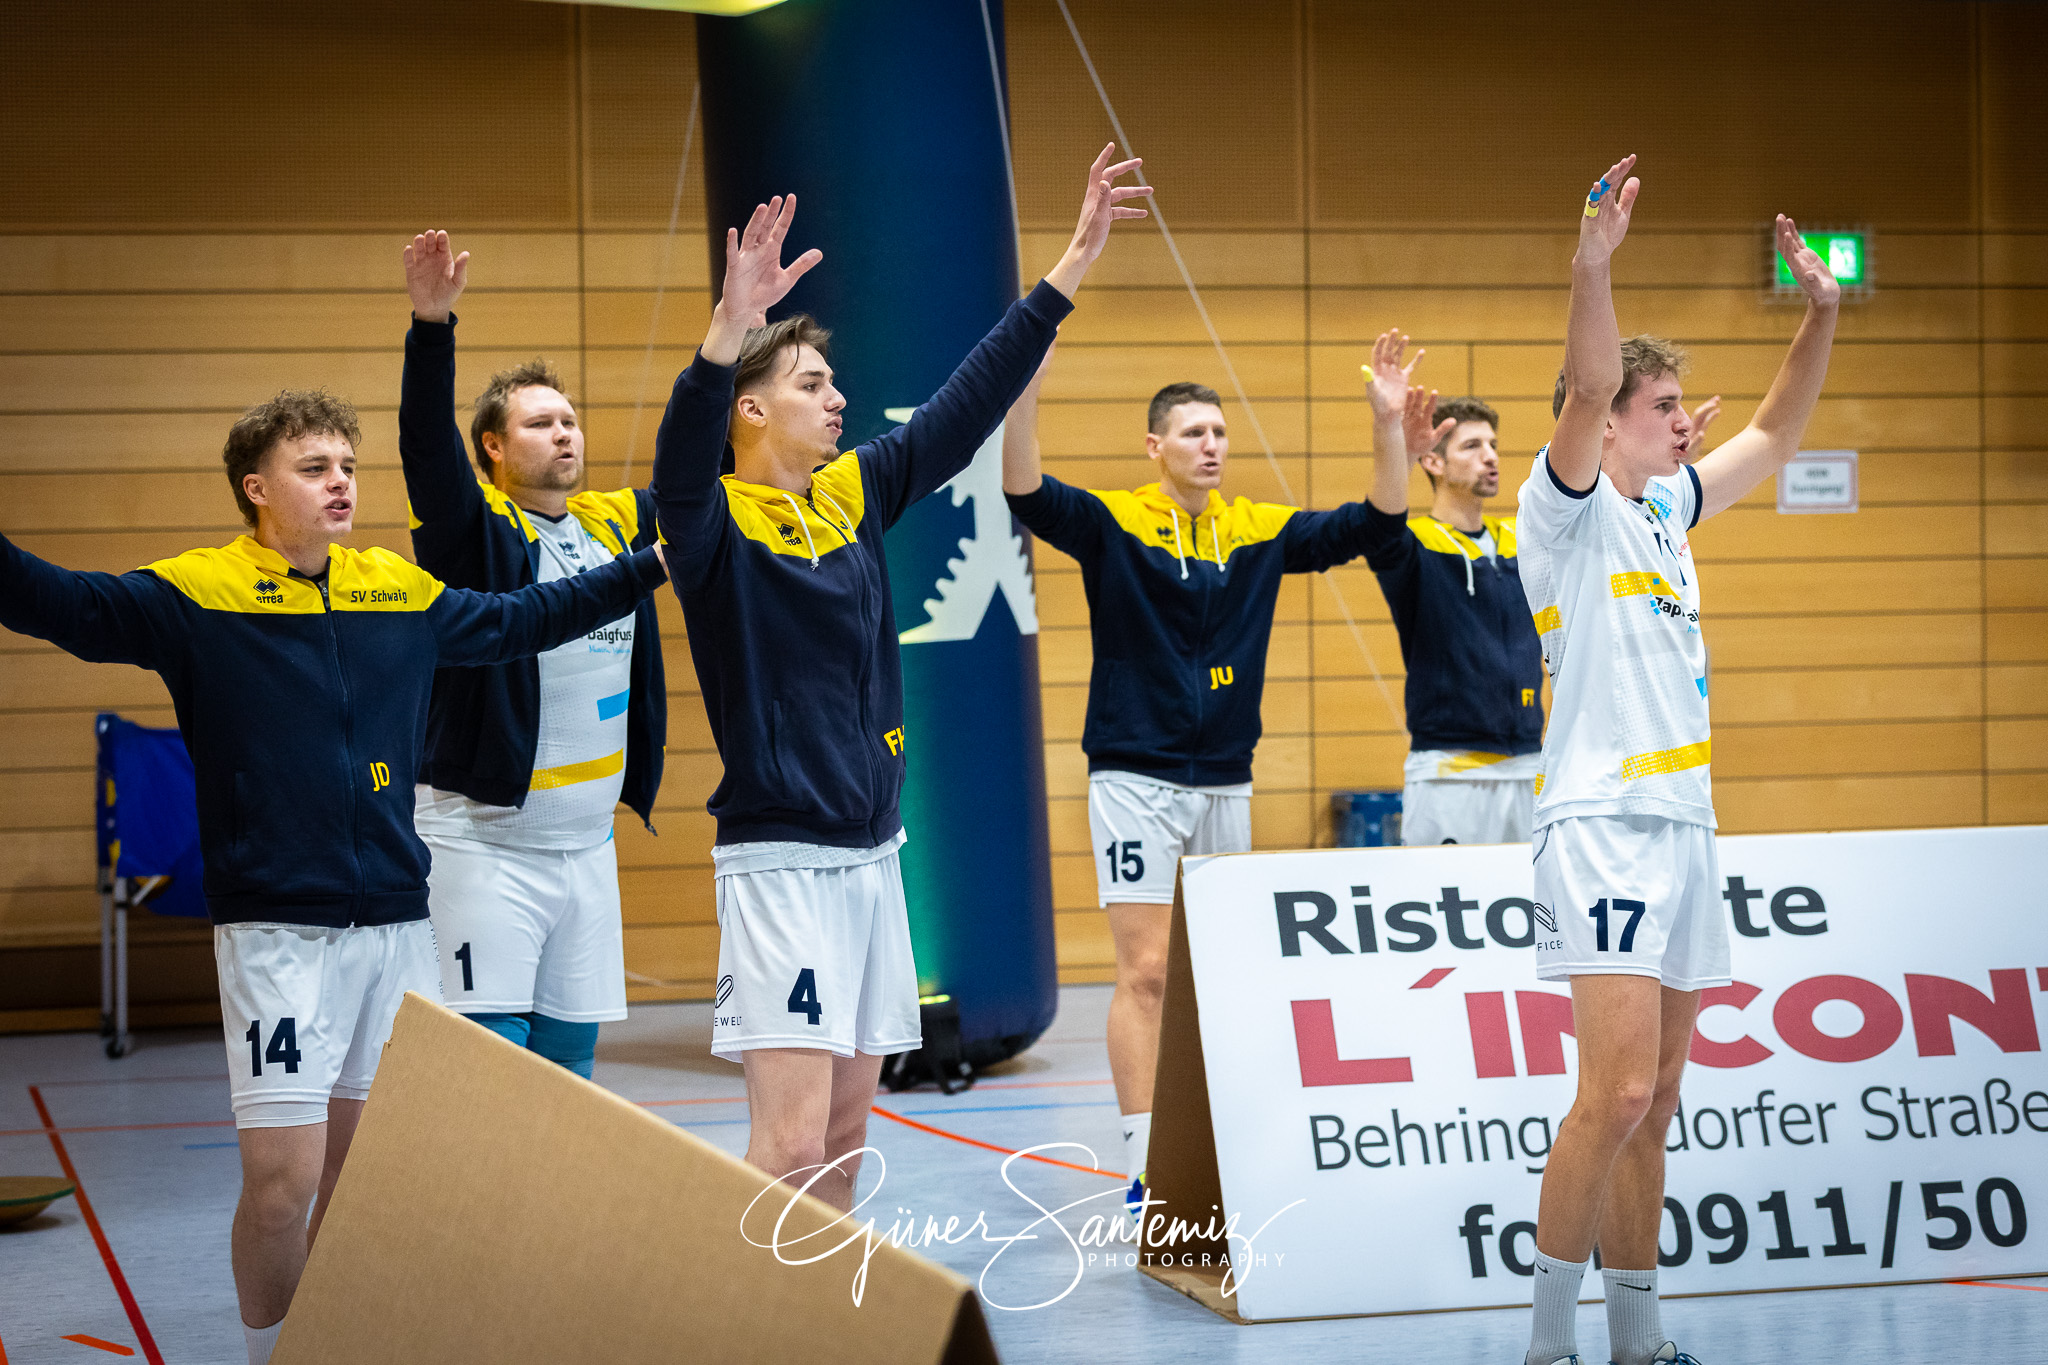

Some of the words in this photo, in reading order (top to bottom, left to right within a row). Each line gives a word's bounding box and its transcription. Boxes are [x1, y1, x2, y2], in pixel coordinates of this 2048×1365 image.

[351, 591, 367, 603] SV
[371, 589, 408, 604] Schwaig
[1210, 666, 1234, 690] JU
[369, 762, 390, 792] JD
[1106, 840, 1144, 883] 15
[1273, 875, 1829, 957] Ristote
[1588, 898, 1646, 953] 17
[454, 942, 475, 991] 1
[787, 967, 822, 1026] 4
[246, 1017, 302, 1078] 14
[1309, 1088, 1836, 1174] Behringdorfer
[1860, 1077, 2048, 1142] Straße
